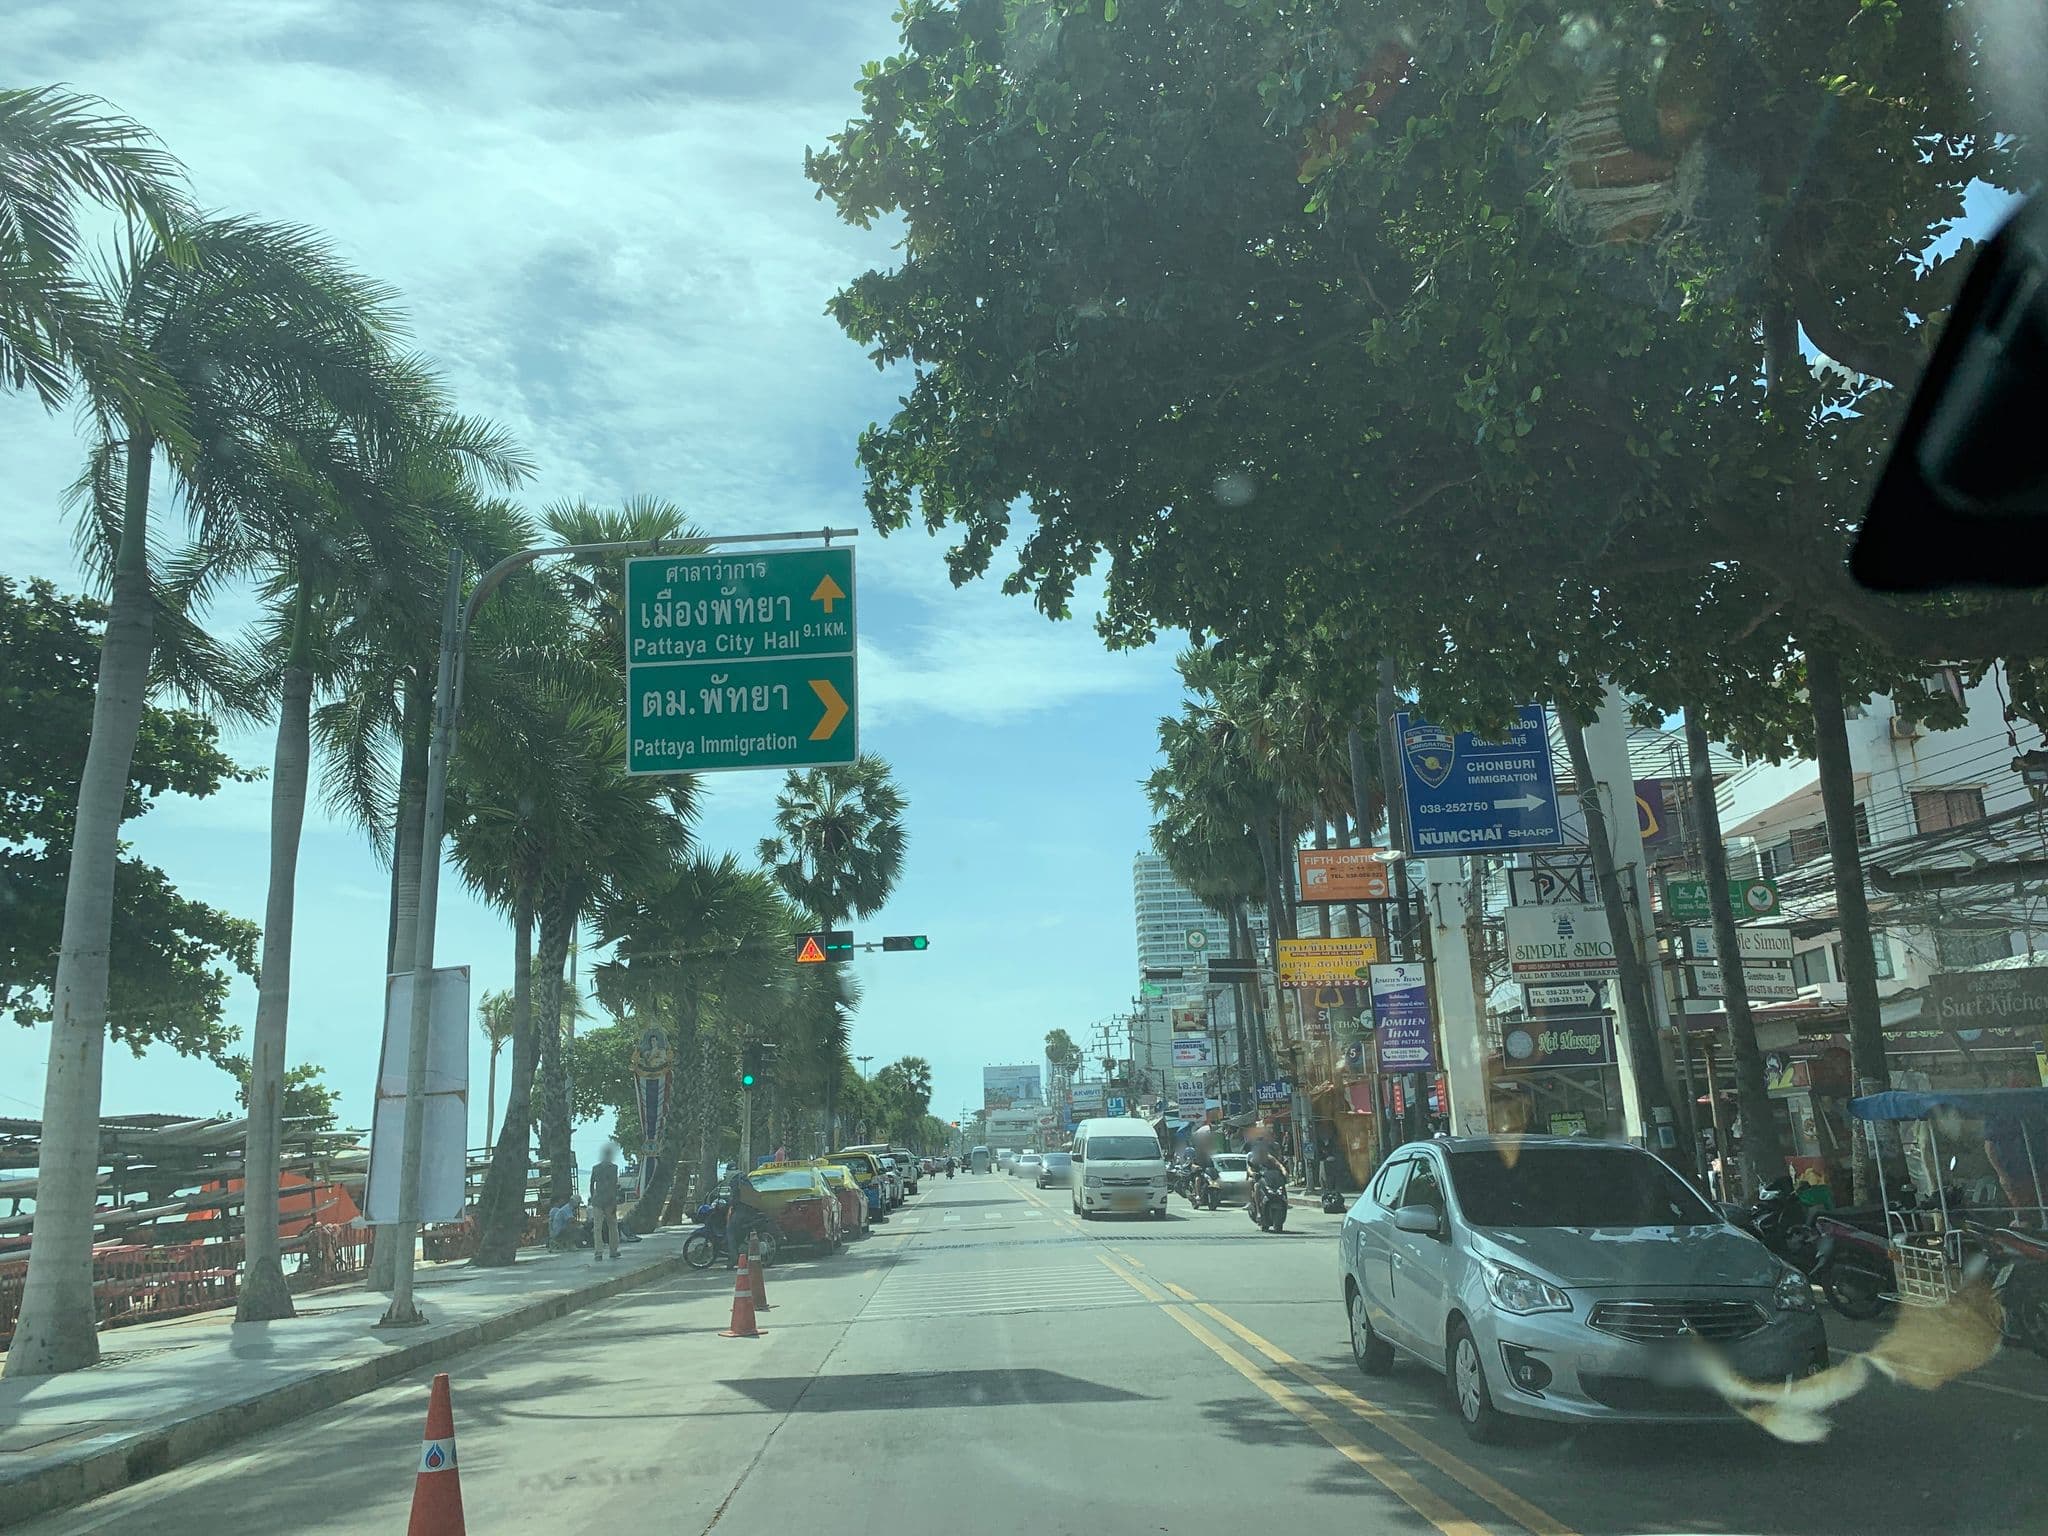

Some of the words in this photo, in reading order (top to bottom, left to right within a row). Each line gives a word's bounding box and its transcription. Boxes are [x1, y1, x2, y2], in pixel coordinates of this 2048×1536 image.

[666, 559, 767, 583] ศาลาว่าการ
[641, 586, 791, 629] เมืองพัทยา
[803, 623, 821, 638] 9.1
[824, 622, 847, 637] KM.
[634, 638, 707, 658] Pattaya
[715, 634, 754, 655] City
[764, 630, 800, 650] Hall
[634, 738, 695, 759] Pattaya
[701, 733, 797, 756] Immigration
[1466, 759, 1535, 772] CHONBURI
[1468, 773, 1538, 785] IMMIGRATION
[1419, 802, 1488, 814] 038-252750
[1508, 828, 1553, 838] SHARP
[1304, 856, 1334, 865] FIFTH
[1336, 854, 1374, 864] JOMTIE
[1754, 933, 1790, 951] Simon
[1516, 943, 1567, 960] SIMPLE
[1573, 941, 1613, 957] SIMO
[1551, 970, 1581, 978] ENGLISH
[1584, 968, 1621, 977] BREAKFAS
[1381, 1017, 1426, 1028] JOMTIEN
[1388, 1028, 1420, 1038] THANI
[1560, 1029, 1601, 1054] Massage
